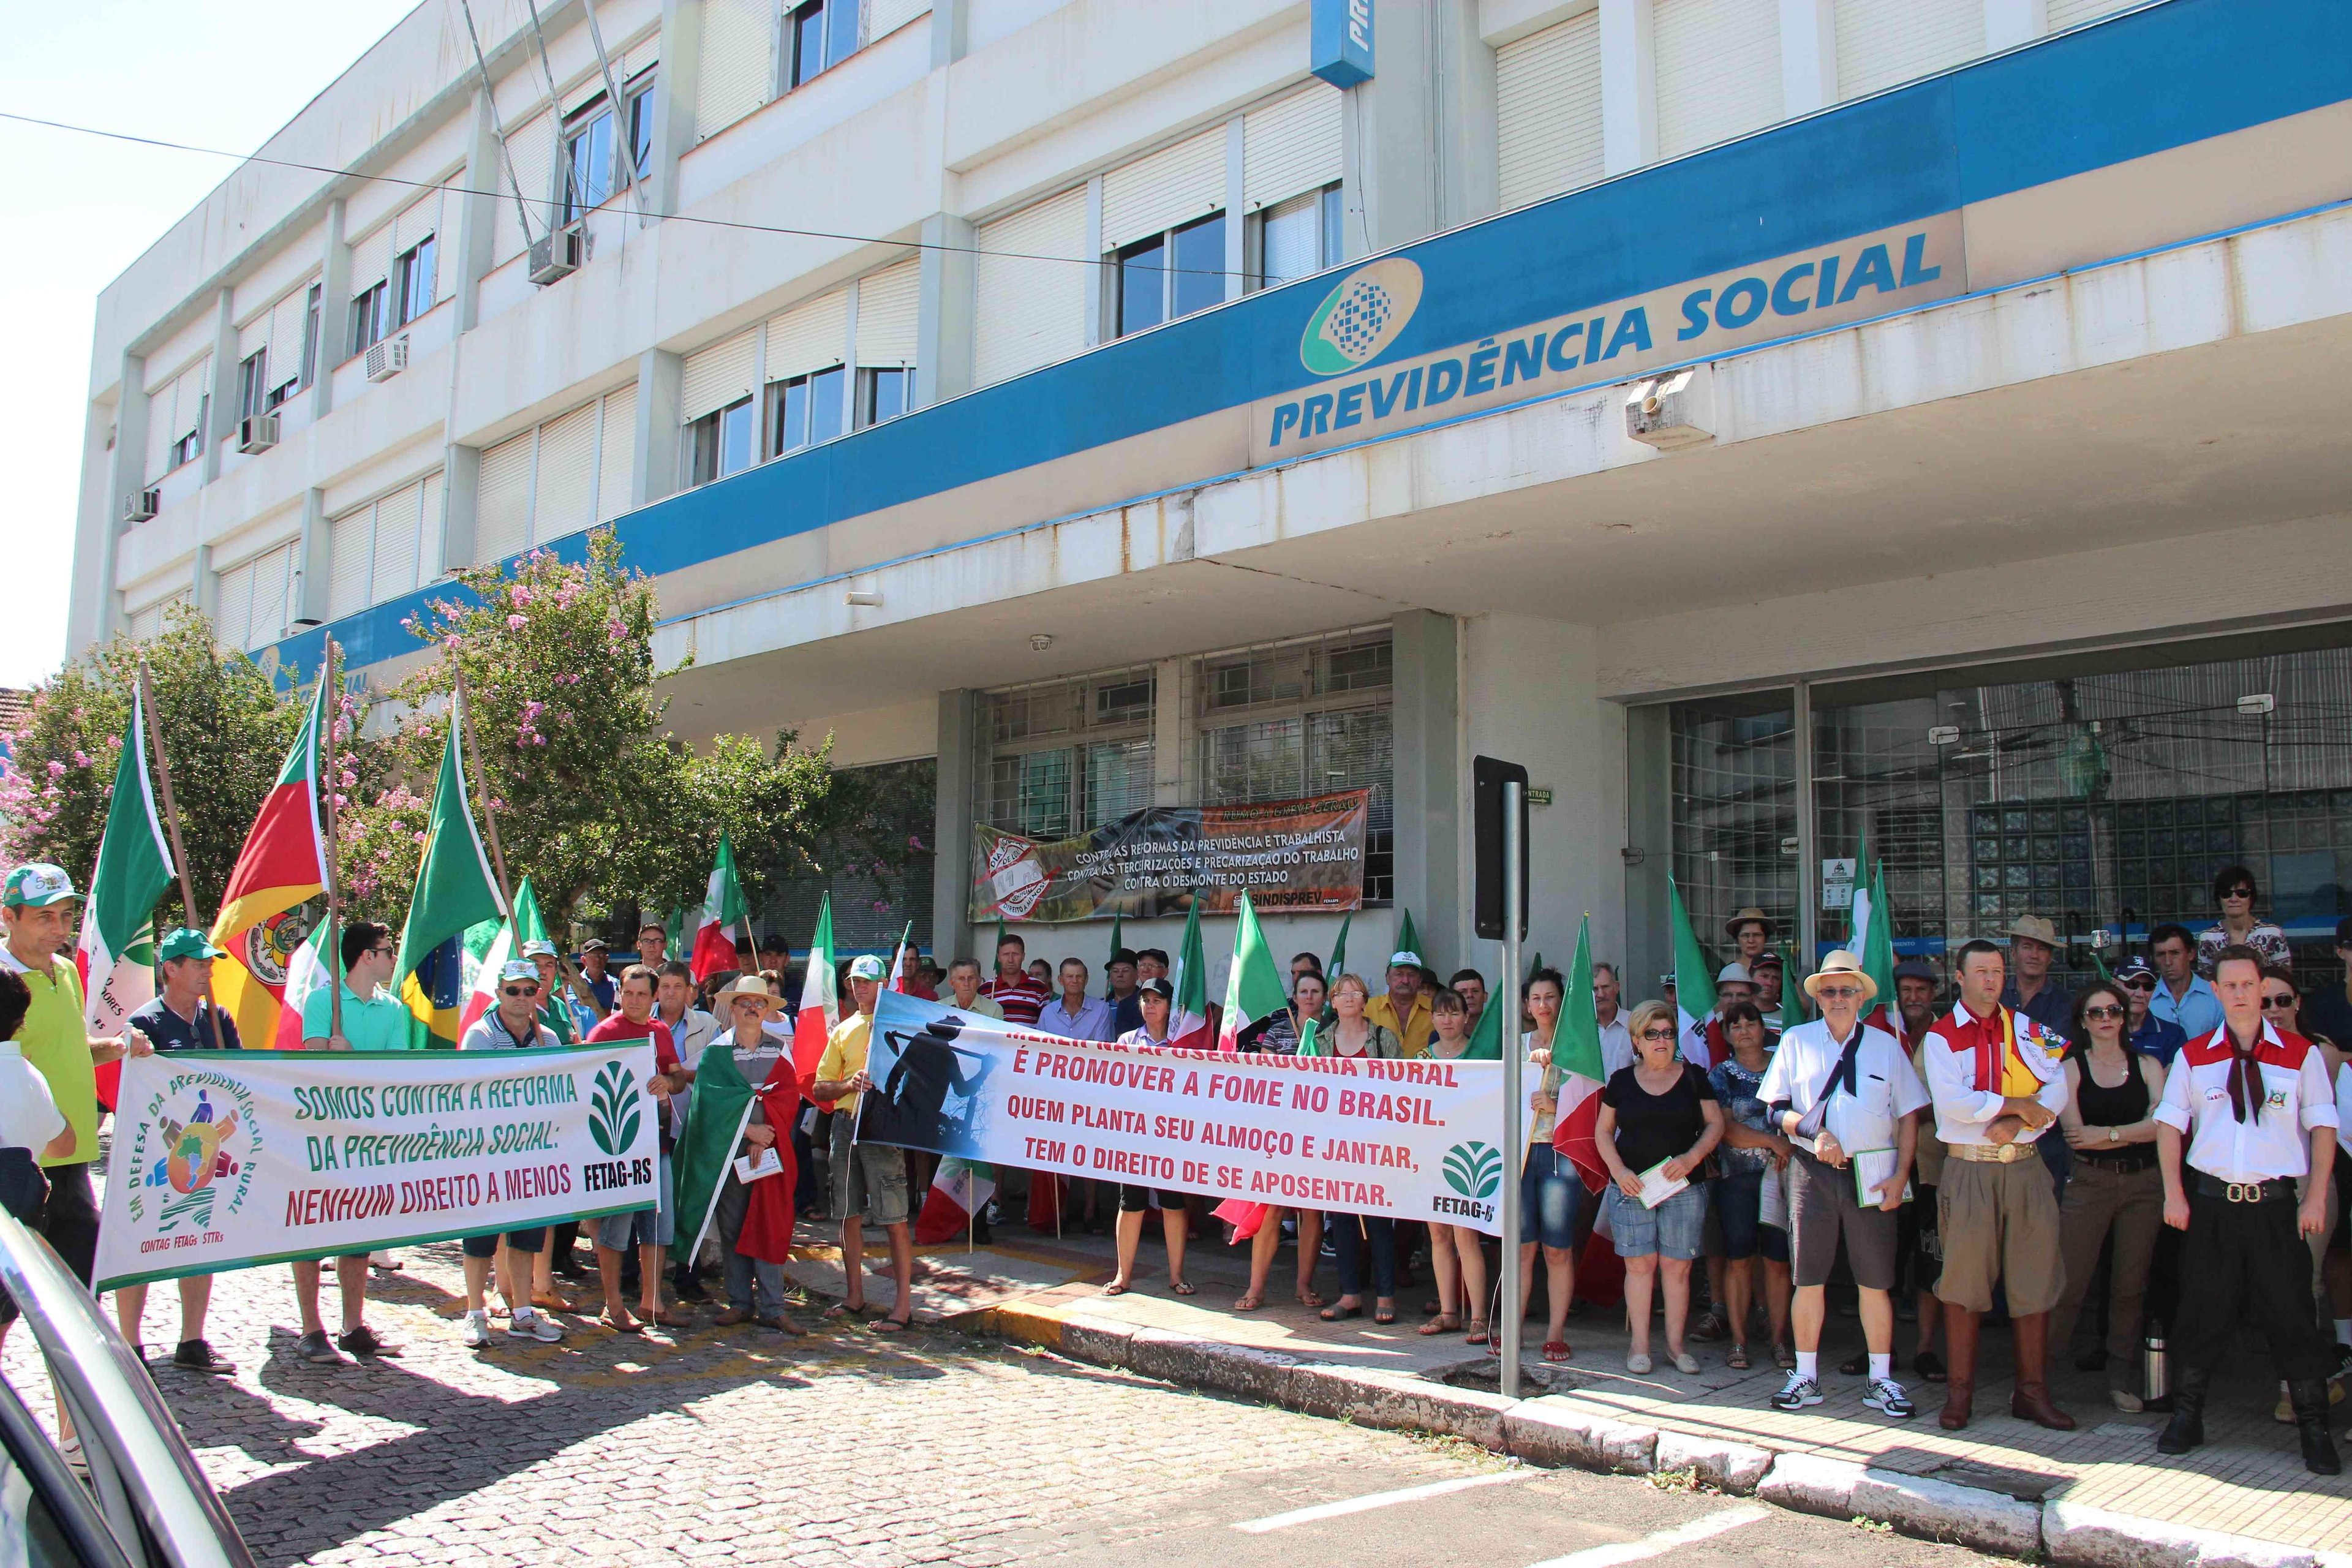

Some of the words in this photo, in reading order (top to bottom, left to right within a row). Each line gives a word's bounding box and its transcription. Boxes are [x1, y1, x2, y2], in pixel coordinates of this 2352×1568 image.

[1270, 304, 1654, 447] PREVIDÊNCIA
[1677, 233, 1941, 342] SOCIAL
[1273, 802, 1311, 817] GREVE
[1528, 790, 1550, 799] NTRADA
[990, 853, 1003, 868] DIA
[1067, 868, 1098, 882] CONTRA
[1101, 865, 1115, 876] AS
[1117, 855, 1192, 874] TERCEIRIZAÇÕES
[1194, 857, 1201, 869] E
[1204, 851, 1280, 869] PRECARIZAÇÃO
[1283, 852, 1300, 864] DO
[1303, 847, 1359, 864] TRABALHO
[1076, 849, 1114, 865] CONTRA
[1114, 845, 1128, 858] AS
[1131, 840, 1178, 856] REFORMAS
[1181, 841, 1195, 852] DA
[1198, 834, 1263, 851] PREVIDÊNCIA
[1265, 835, 1272, 848] E
[1273, 830, 1346, 845] TRABALHISTA
[1124, 877, 1159, 891] CONTRA
[1162, 876, 1169, 888] O
[1172, 873, 1223, 887] DESMONTE
[1225, 873, 1244, 885] DO
[1248, 870, 1288, 884] ESTADO
[1003, 903, 1023, 913] DIREITO
[1253, 891, 1322, 907] SINDISPREV
[1014, 1044, 1029, 1074] É
[1035, 1052, 1175, 1093] PROMOVER
[1182, 1071, 1199, 1096] A
[1208, 1074, 1283, 1107] FOME
[1292, 1084, 1329, 1114] NO
[1338, 1089, 1446, 1127] BRASIL.
[1366, 1059, 1458, 1088] RURAL
[148, 1091, 166, 1117] DA
[293, 1085, 376, 1121] SOMOS
[380, 1082, 465, 1118] CONTRA
[469, 1081, 483, 1110] A
[487, 1072, 578, 1109] REFORMA
[240, 1101, 263, 1155] SOCIAL
[1007, 1094, 1065, 1124] QUEM
[1071, 1104, 1147, 1136] PLANTA
[1155, 1115, 1194, 1142] SEU
[1200, 1121, 1294, 1159] ALMOÇO
[1302, 1134, 1315, 1158] E
[1322, 1137, 1419, 1174] JANTAR,
[129, 1122, 151, 1189] DEFESA
[306, 1134, 339, 1172] DA
[343, 1123, 484, 1169] PREVIDÊNCIA
[487, 1121, 559, 1156] SOCIAL:
[228, 1162, 257, 1215] RURAL
[583, 1157, 652, 1193] FETAG-RS
[1025, 1137, 1066, 1164] TEM
[1072, 1144, 1087, 1167] O
[1093, 1147, 1174, 1180] DIREITO
[1182, 1159, 1210, 1186] DE
[1217, 1165, 1243, 1190] SE
[1250, 1170, 1392, 1208] APOSENTAR.
[129, 1194, 145, 1224] EM
[285, 1184, 396, 1227] NENHUM
[400, 1172, 481, 1214] DIREITO
[486, 1172, 500, 1204] A
[505, 1163, 571, 1201] MENOS
[1433, 1195, 1495, 1223] FETAG-RS
[140, 1237, 170, 1254] CONTAG
[175, 1234, 198, 1248] FETAGs
[203, 1231, 224, 1245] STTRs
